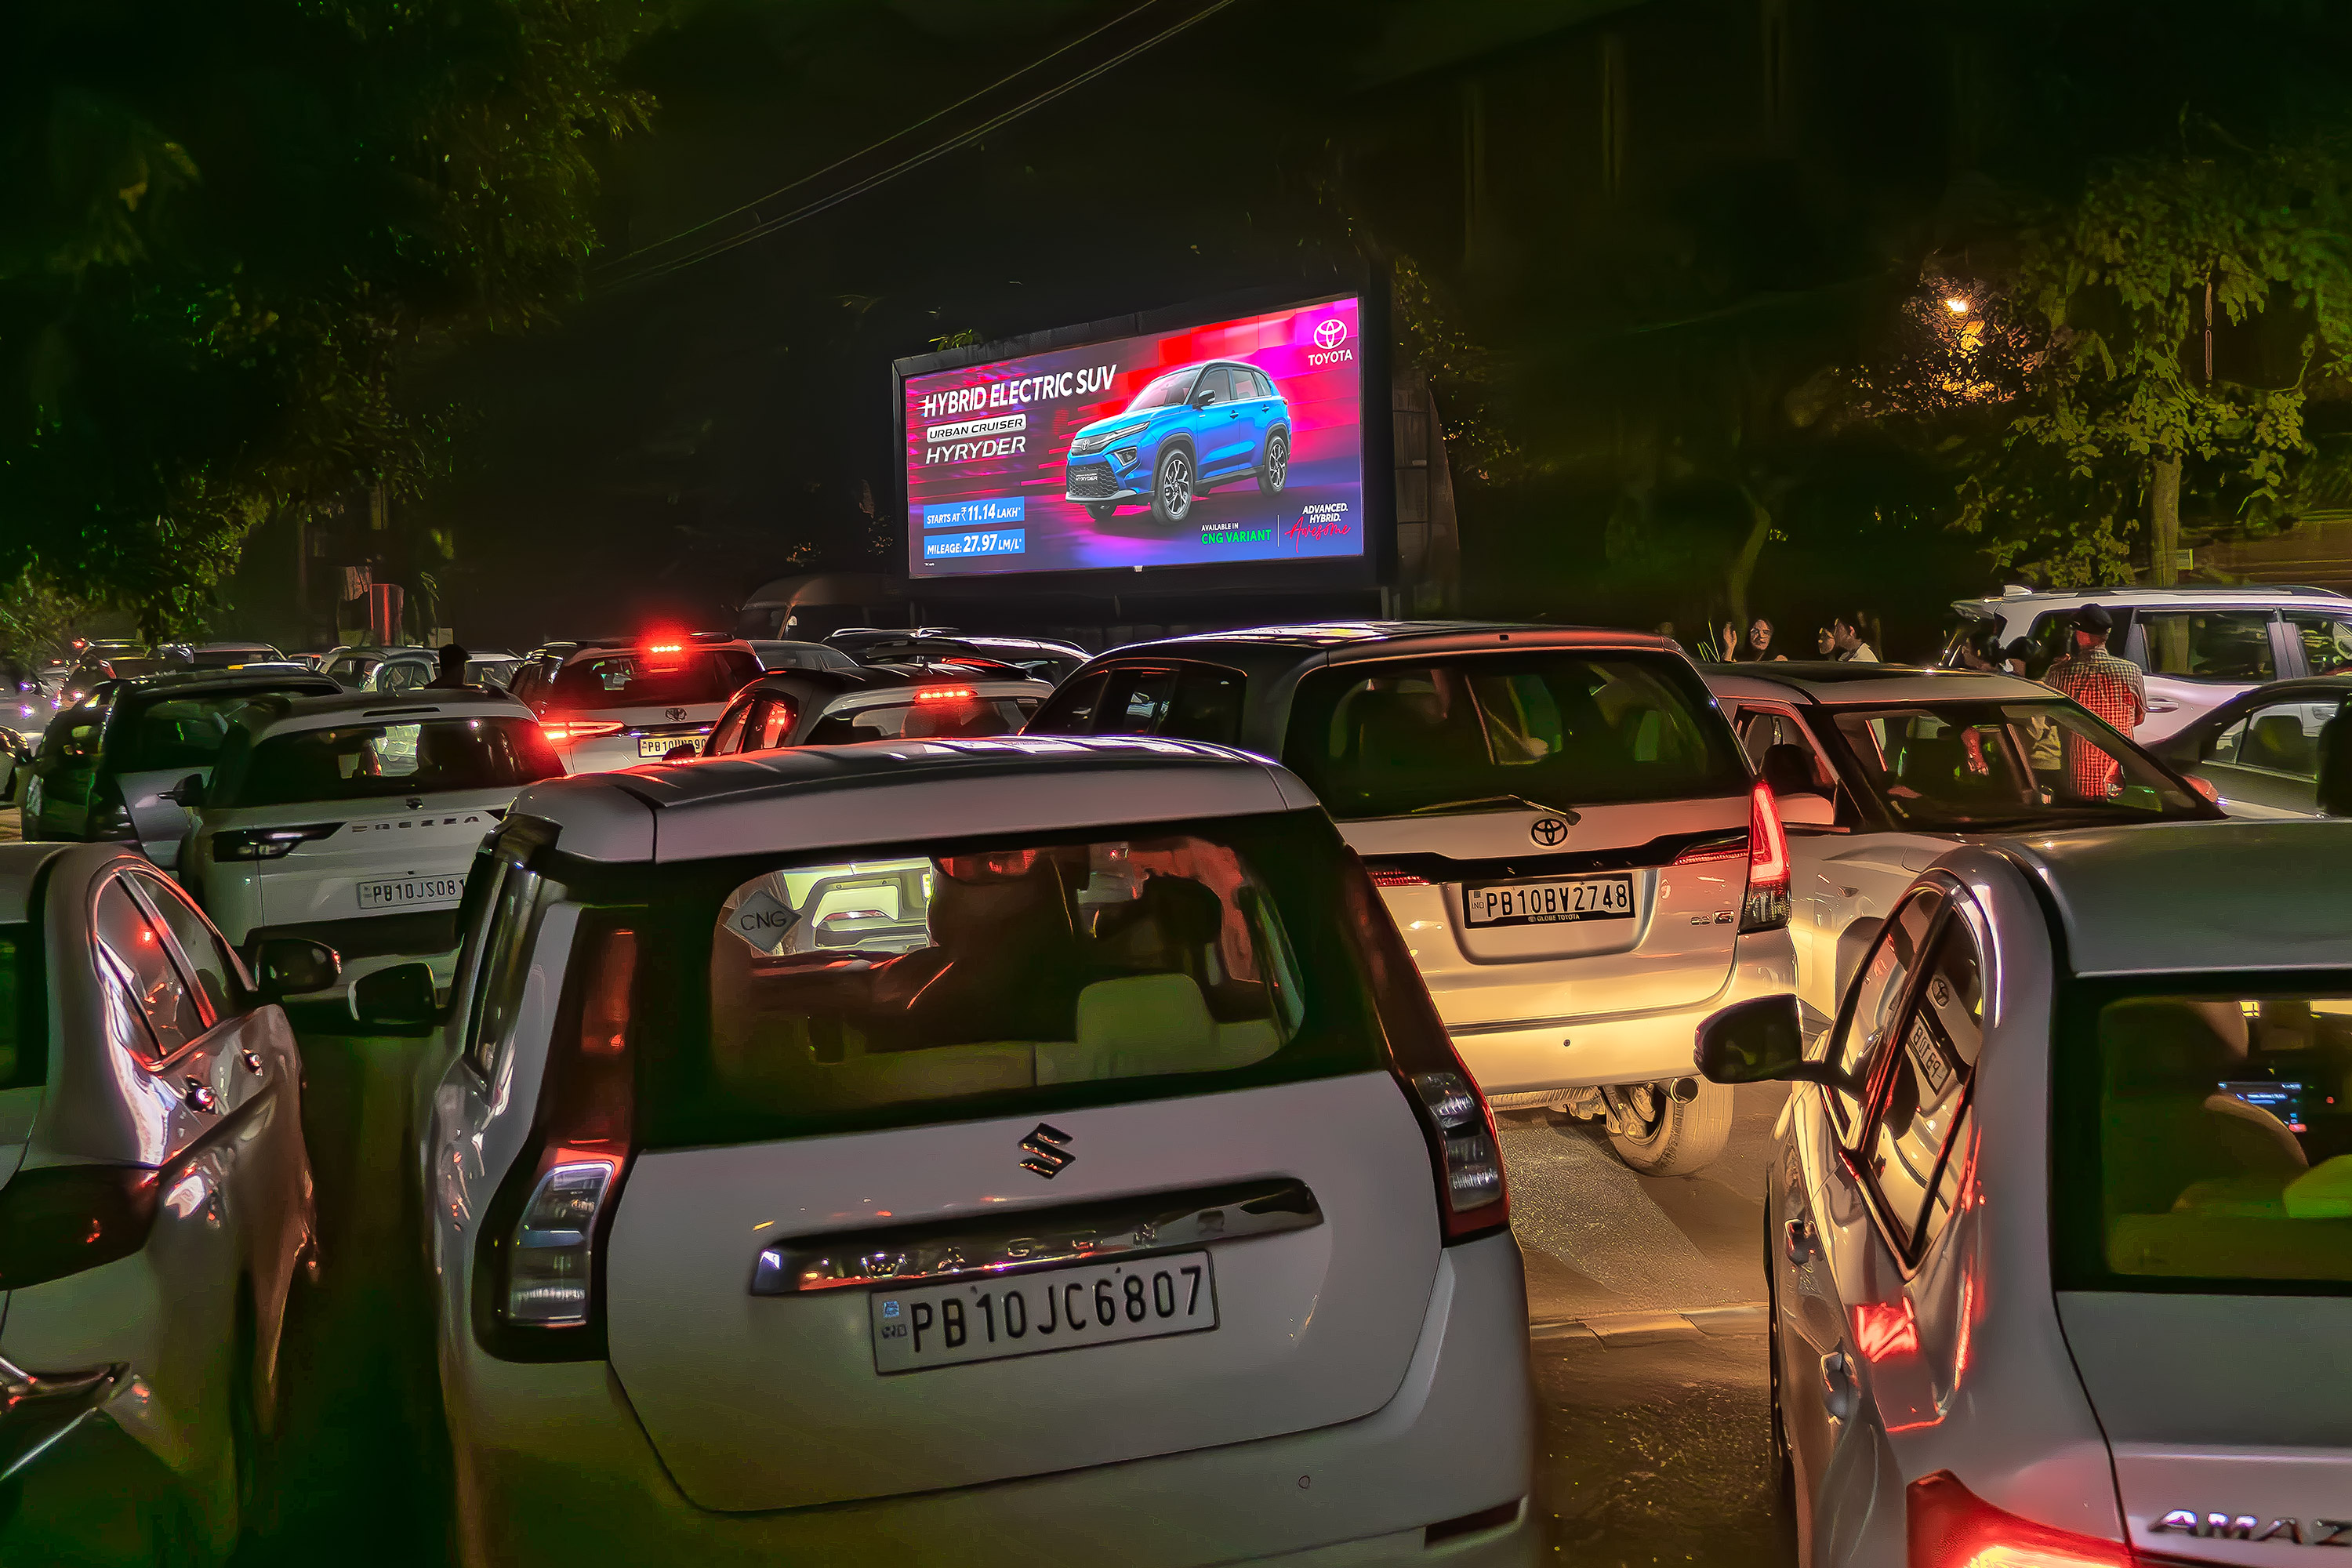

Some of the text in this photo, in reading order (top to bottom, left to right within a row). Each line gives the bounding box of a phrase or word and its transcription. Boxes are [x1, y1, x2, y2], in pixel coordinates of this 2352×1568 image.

[1308, 349, 1353, 366] TOYOTA
[920, 364, 1117, 418] HYBRID ELECTRIC SUV
[930, 418, 1023, 440] URBAN CRUISER
[925, 436, 1027, 465] HYRYDER
[927, 514, 951, 524] STARTS
[951, 513, 961, 522] AT
[1302, 503, 1349, 515] ADVANCED.
[1309, 512, 1341, 524] HYBRID.
[1201, 523, 1232, 532] AVAILABLE
[1201, 529, 1272, 545] CNG VARIANT
[1284, 516, 1352, 554] Awesome
[927, 543, 963, 555] MILEAGE:
[963, 533, 998, 553] 27.97
[1486, 884, 1628, 918] PB10BV2748
[740, 910, 787, 931] CNG
[910, 1265, 1202, 1354] PB10JC6807
